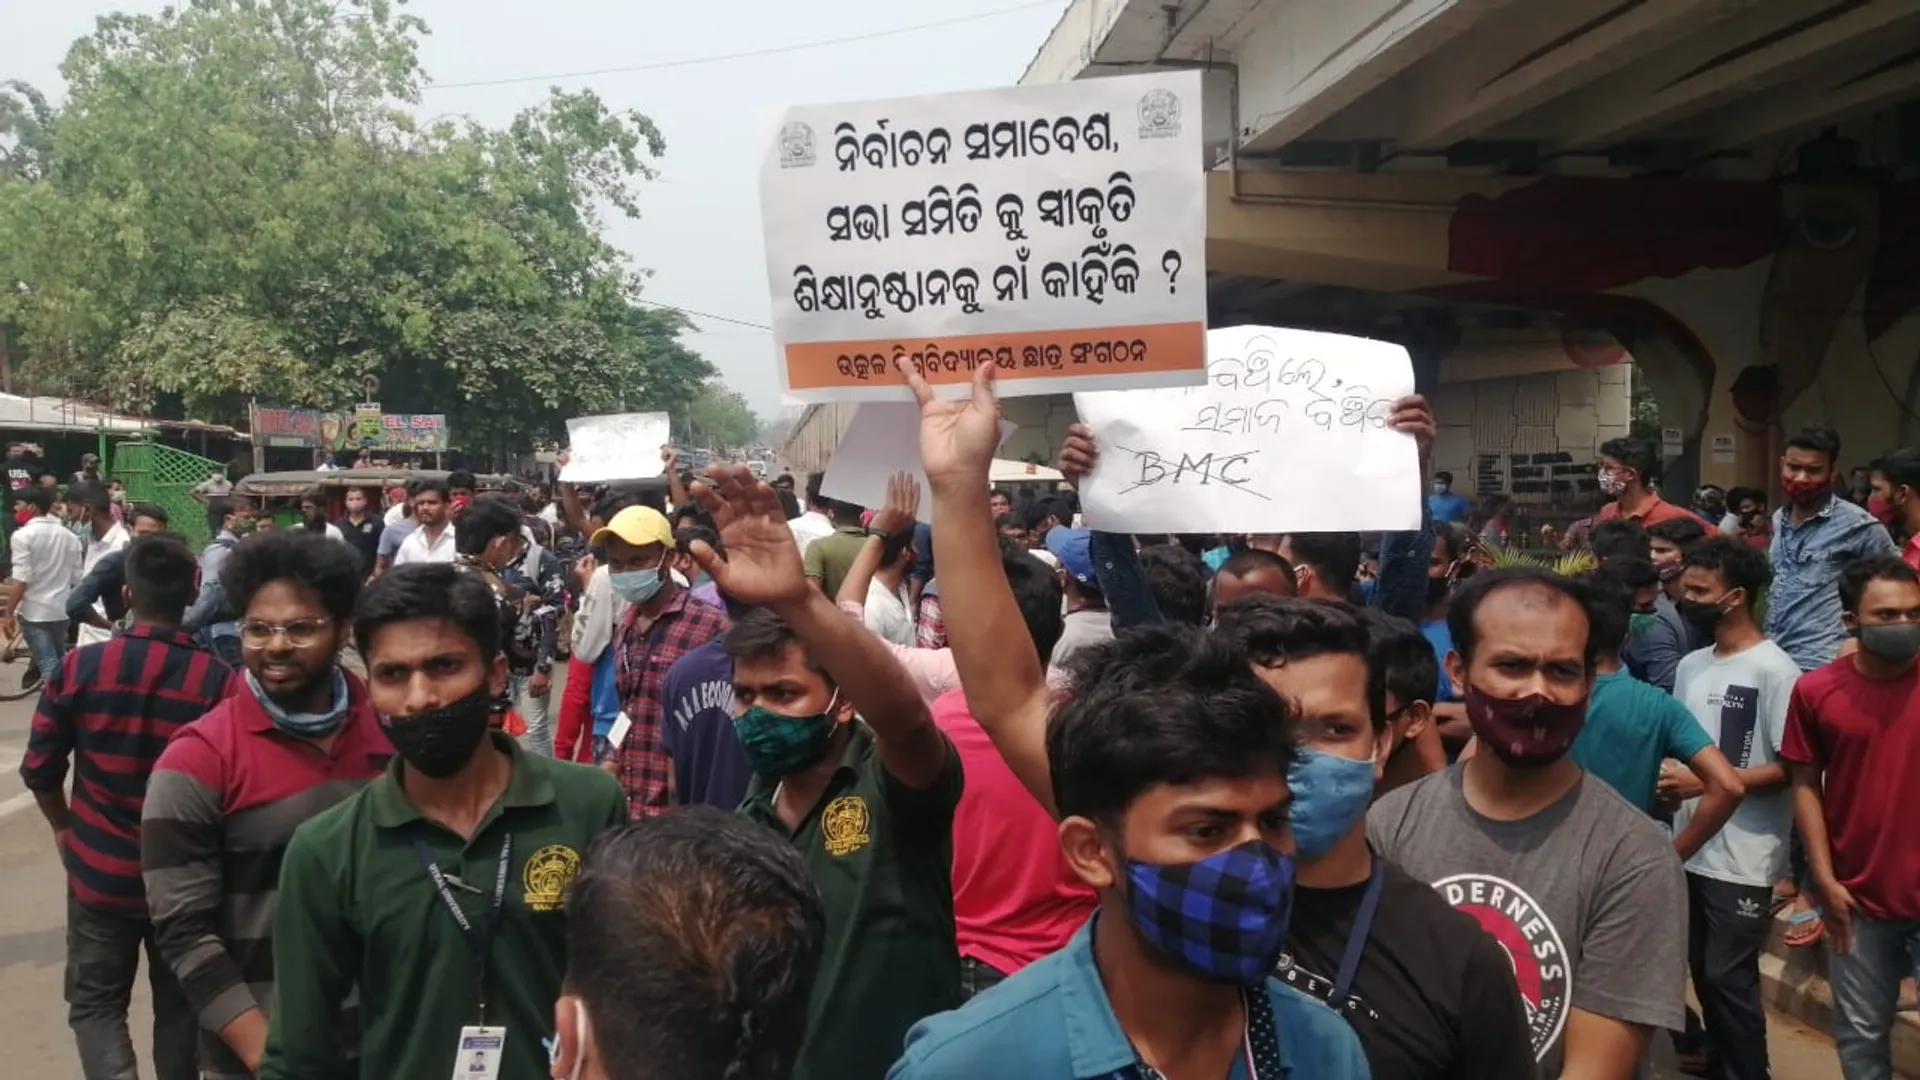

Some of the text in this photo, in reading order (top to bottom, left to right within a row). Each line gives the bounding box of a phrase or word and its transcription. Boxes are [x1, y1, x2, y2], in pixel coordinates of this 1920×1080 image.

[833, 112, 1119, 172] ନିର୍ବାଚନ ସମାବେଶ,
[826, 203, 890, 242] ସଭା
[902, 182, 982, 236] ସମିତି
[996, 193, 1028, 241] କୁ
[792, 263, 985, 320] ଶିକ୍ଷାନୁଷ୍ଠାନକୁ
[1041, 242, 1139, 305] କାହିଁକି
[1162, 249, 1182, 296] ?
[1023, 345, 1064, 370] ଛାତ୍ର
[1134, 451, 1251, 486] BMC
